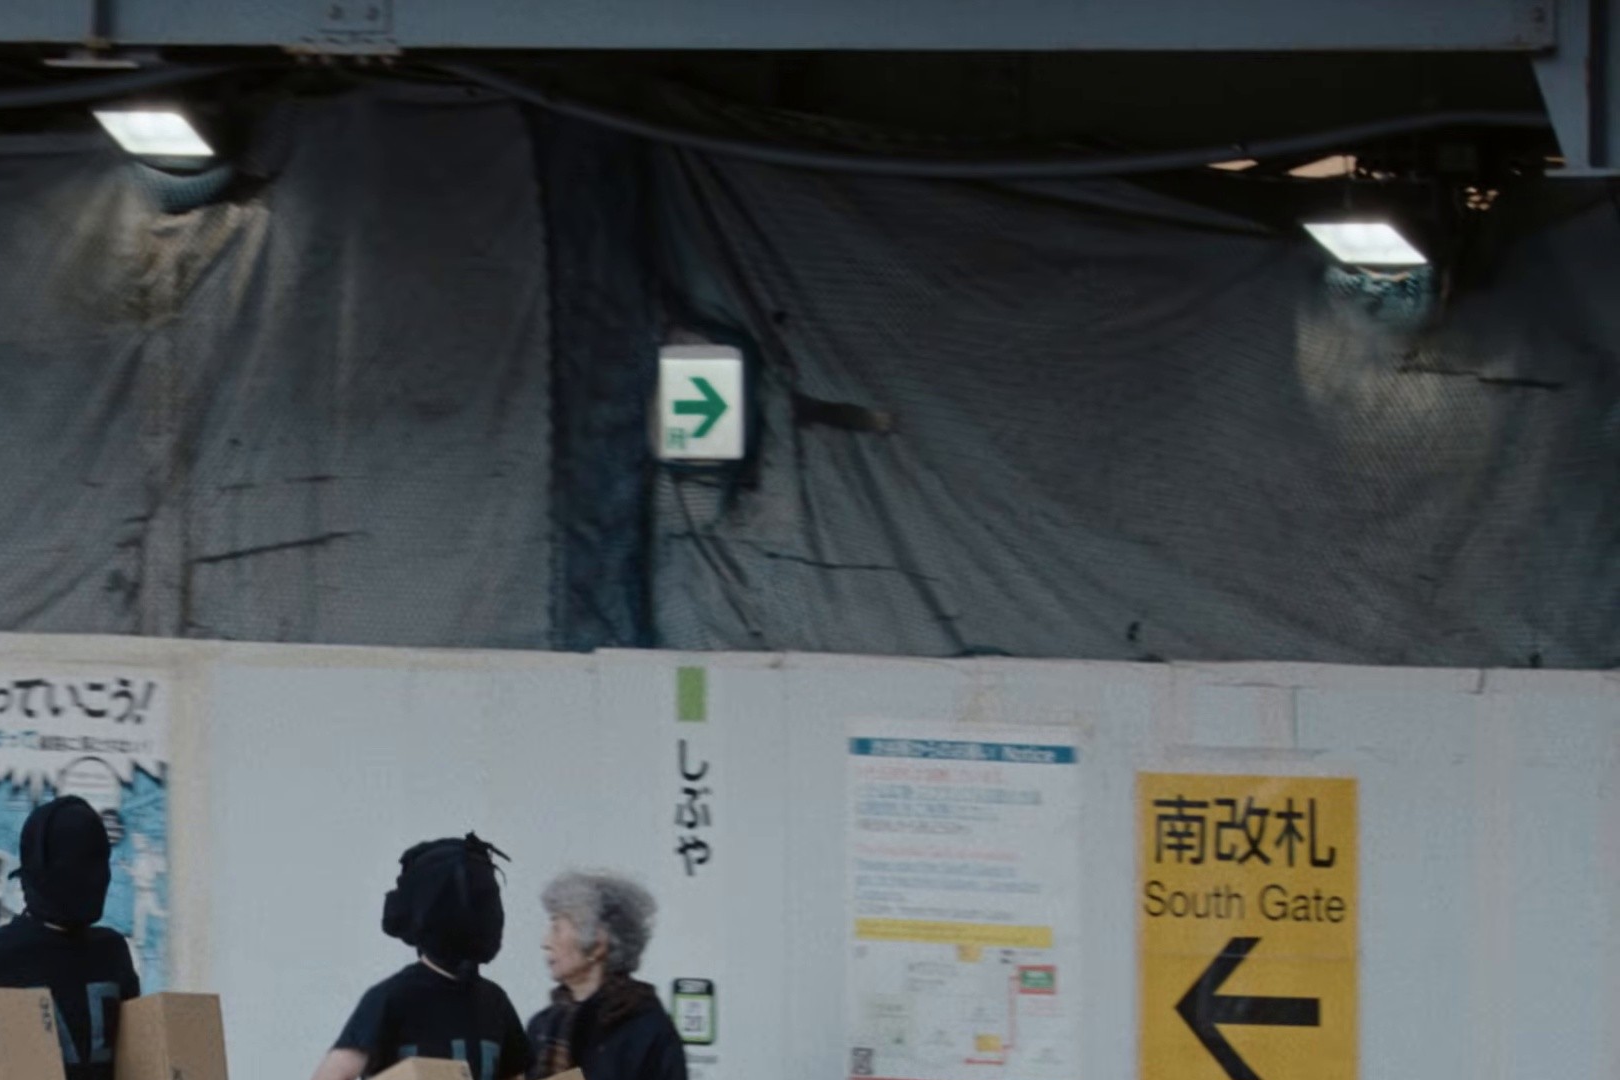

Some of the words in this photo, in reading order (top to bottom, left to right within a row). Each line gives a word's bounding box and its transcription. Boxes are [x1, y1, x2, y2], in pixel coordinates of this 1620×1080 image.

[673, 739, 712, 876] しぶや
[1153, 795, 1336, 868] 南改札
[1144, 880, 1246, 920] South
[1259, 884, 1346, 923] Gate
